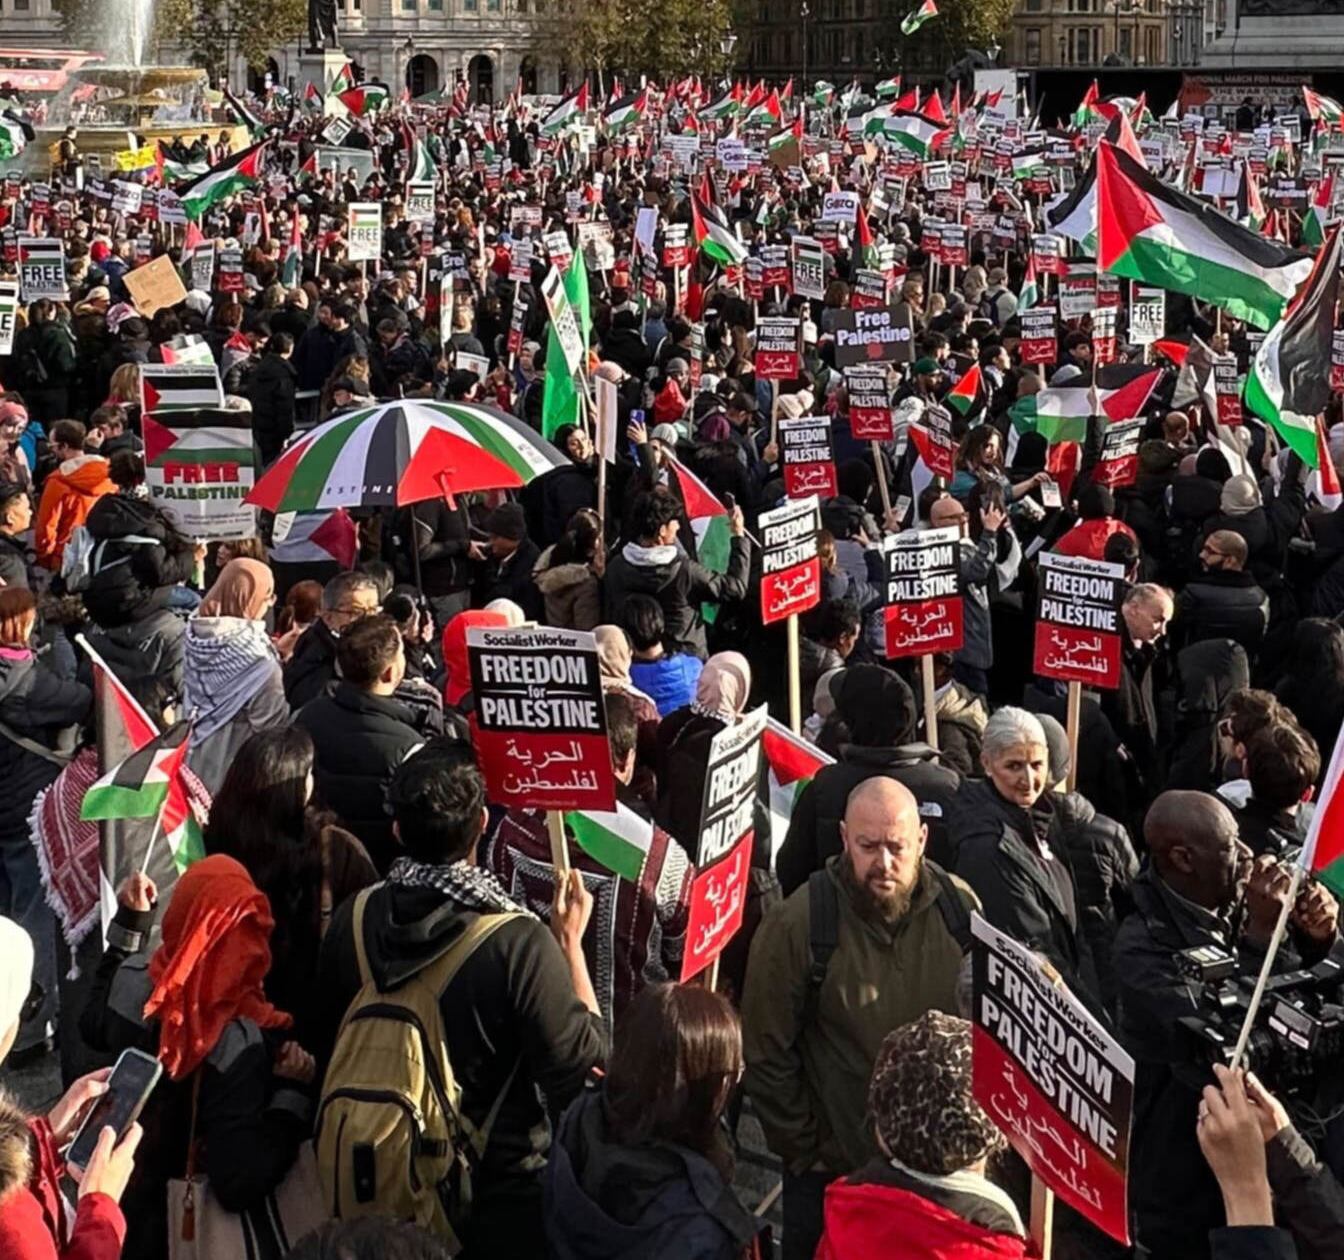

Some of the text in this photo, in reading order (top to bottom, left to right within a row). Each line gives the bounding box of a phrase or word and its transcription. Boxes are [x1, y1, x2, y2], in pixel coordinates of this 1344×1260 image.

[407, 196, 433, 210] FREE
[825, 197, 855, 210] Gaza
[350, 227, 378, 241] FREE
[21, 265, 63, 281] FREE
[794, 262, 823, 278] FREE
[856, 311, 891, 328] Free
[1131, 305, 1163, 321] FREE
[760, 325, 796, 337] FREEDOM
[837, 326, 911, 346] Palestine
[758, 341, 796, 351] PALESTINE
[848, 378, 885, 391] FREEDOM
[849, 394, 888, 408] PALESTINE
[785, 428, 827, 443] FREEDOM
[784, 447, 831, 463] PALESTINE
[164, 462, 240, 484] FREE
[764, 512, 815, 547] FREEDOM
[763, 537, 817, 574] PALESTINE
[890, 545, 953, 573] FREEDOM
[887, 575, 958, 603] PALESTINE
[1045, 571, 1114, 600] FREEDOM
[900, 604, 946, 626] الحرية
[1040, 599, 1116, 631] PALESTINE
[484, 633, 577, 647] Socialist Worker
[1051, 630, 1102, 652] الحرية
[480, 654, 588, 685] FREEDOM
[528, 685, 546, 698] for
[481, 698, 599, 729] PALESTINE
[506, 739, 583, 768] الحرية
[503, 768, 598, 793] لفلسطين
[988, 953, 1112, 1104] FREEDOM
[1053, 988, 1108, 1051] Worker
[1036, 1036, 1057, 1066] for
[981, 994, 1117, 1160] PALESTINE
